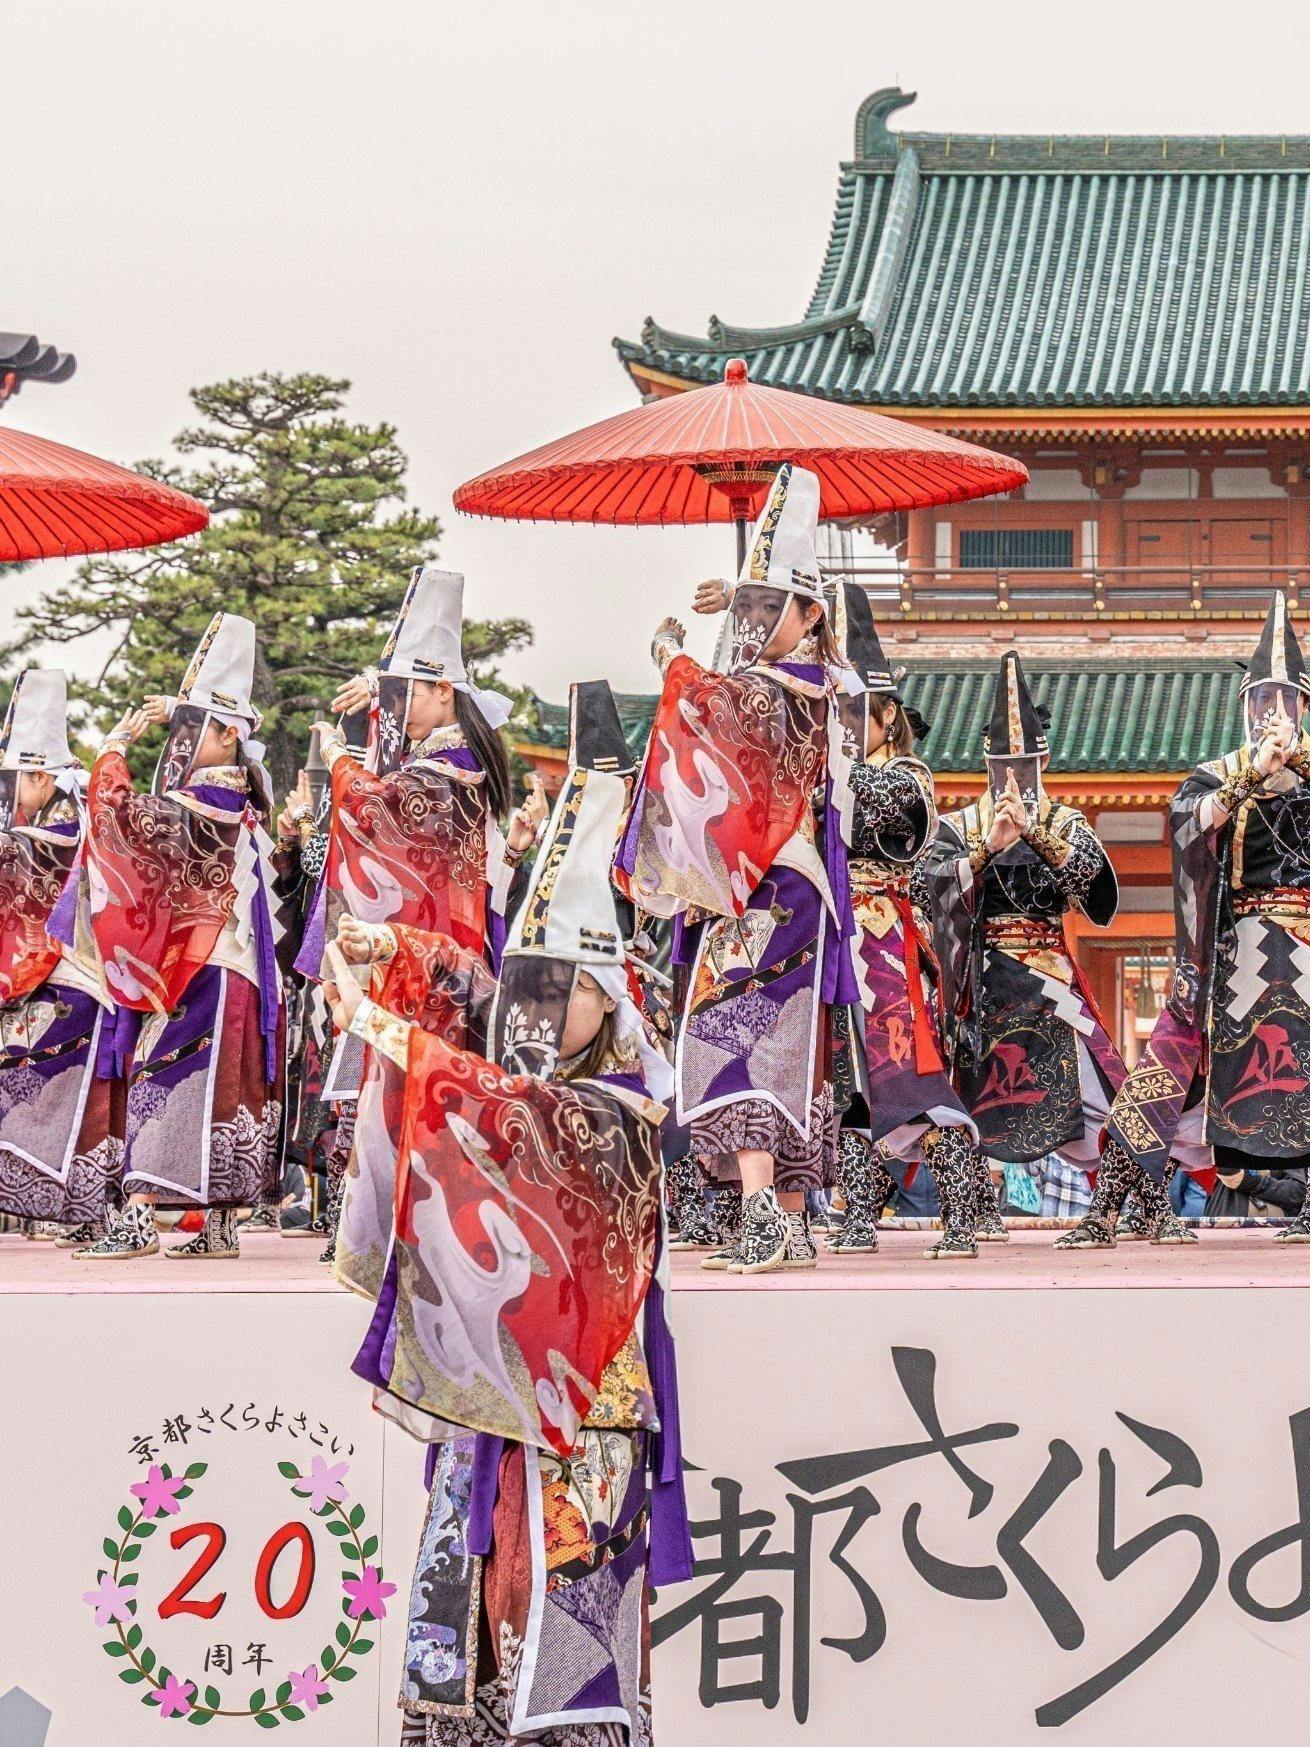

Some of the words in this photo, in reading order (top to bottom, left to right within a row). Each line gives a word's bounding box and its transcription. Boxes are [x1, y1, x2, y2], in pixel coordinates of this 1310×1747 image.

[128, 1402, 354, 1465] 京都さくらよさこい
[157, 1521, 315, 1619] 20
[204, 1642, 274, 1676] 周年
